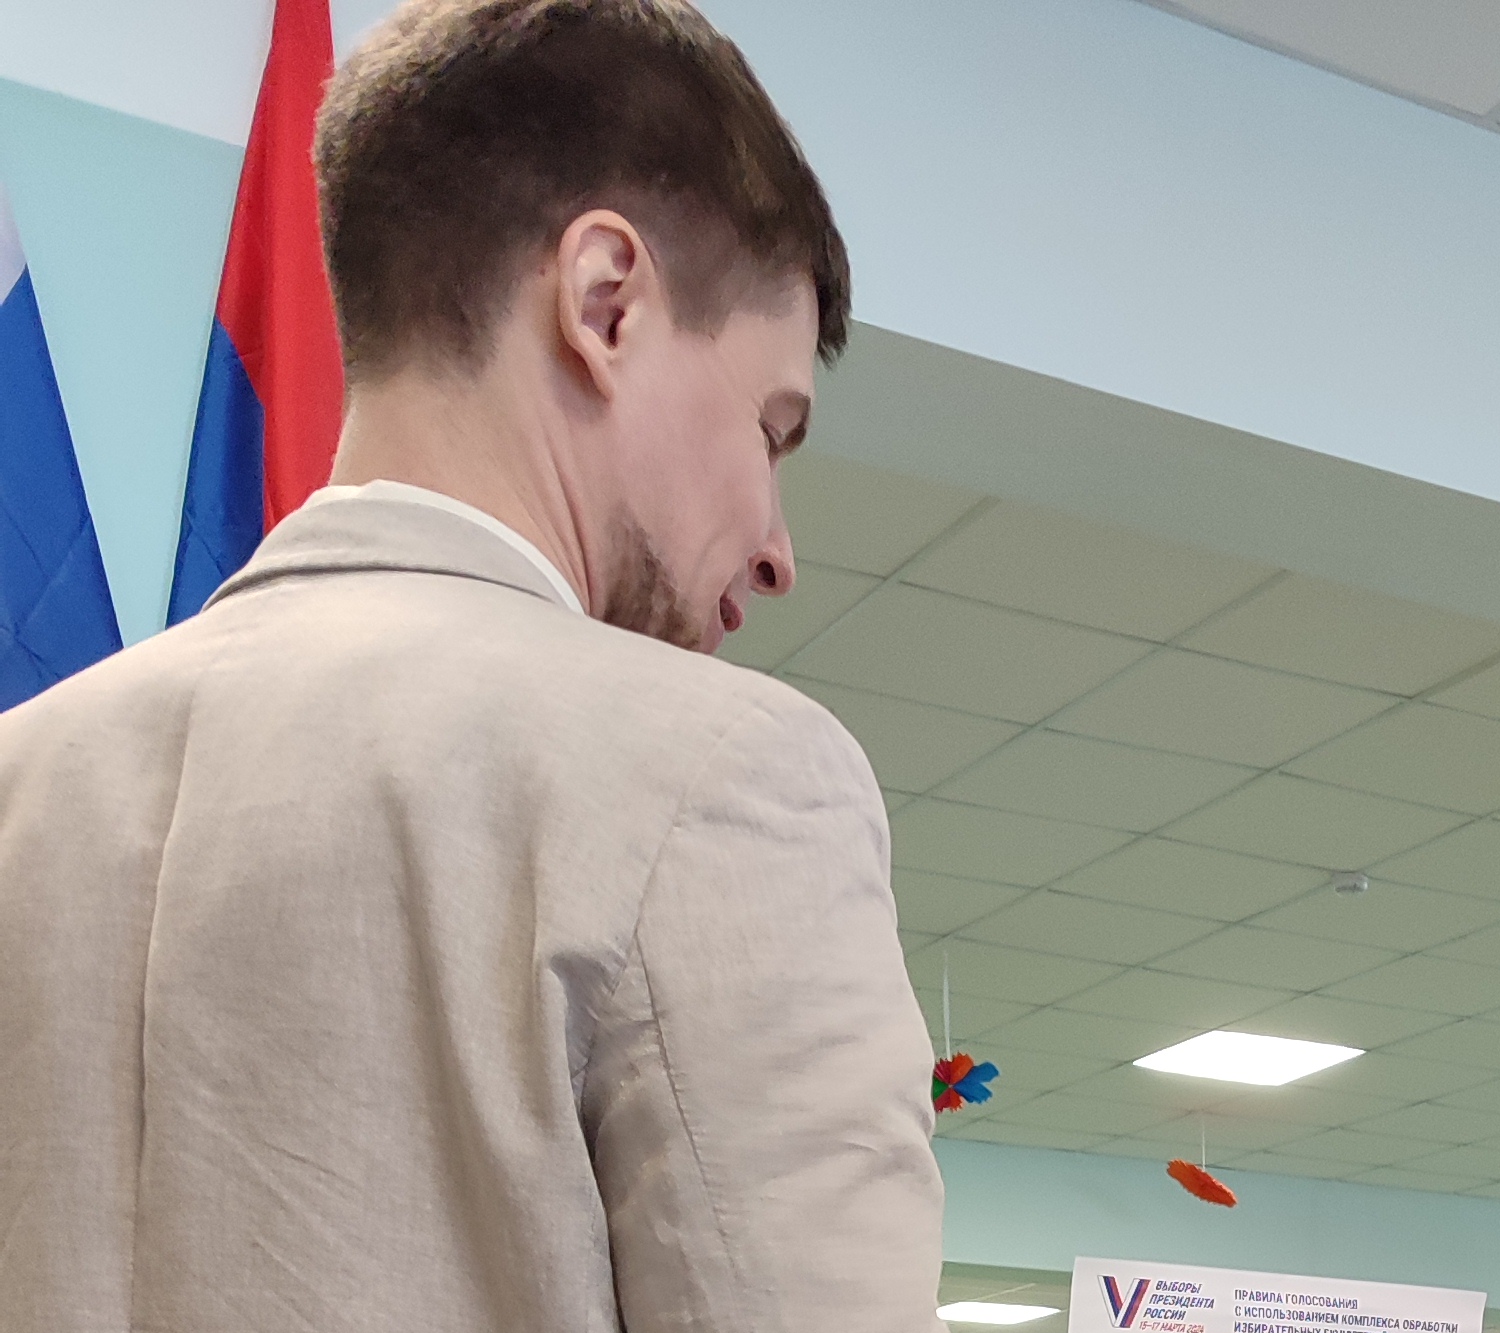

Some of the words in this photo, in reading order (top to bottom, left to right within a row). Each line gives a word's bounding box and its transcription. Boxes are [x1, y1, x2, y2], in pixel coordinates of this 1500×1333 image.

[1156, 1280, 1202, 1293] ВЫБОРЫ
[1149, 1294, 1215, 1308] ПРЕЗИДЕНТА
[1235, 1289, 1283, 1303] ПРАВИЛА
[1285, 1293, 1358, 1309] ГОЛОСОВАНИЯ
[1143, 1308, 1186, 1320] РОССИИ
[1235, 1306, 1241, 1316] С
[1244, 1306, 1339, 1324] ИСПОЛЬЗОВАНИЕМ
[1341, 1314, 1400, 1329] КОМПЛЕКСА
[1403, 1320, 1458, 1333] ОБРАБОТКИ
[1160, 1323, 1185, 1332] МАРТА
